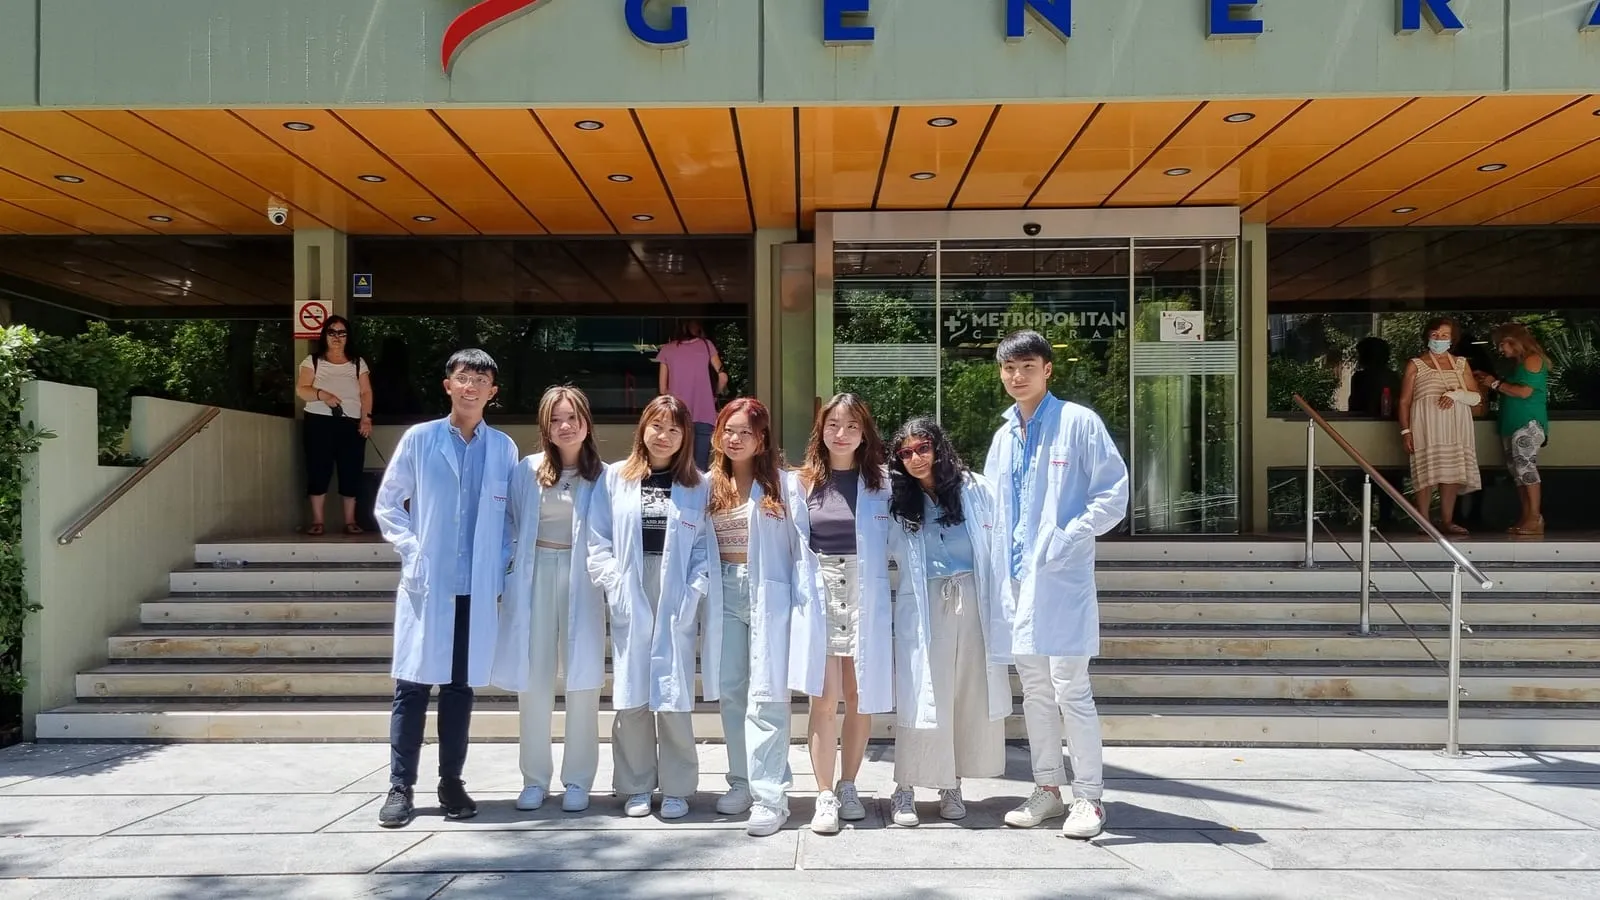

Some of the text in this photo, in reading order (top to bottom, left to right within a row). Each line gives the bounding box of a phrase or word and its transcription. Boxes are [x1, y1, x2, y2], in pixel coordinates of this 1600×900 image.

[625, 0, 1600, 48] GENE
[971, 312, 1126, 328] METROPOLITAN
[972, 329, 1126, 339] GEERAL
